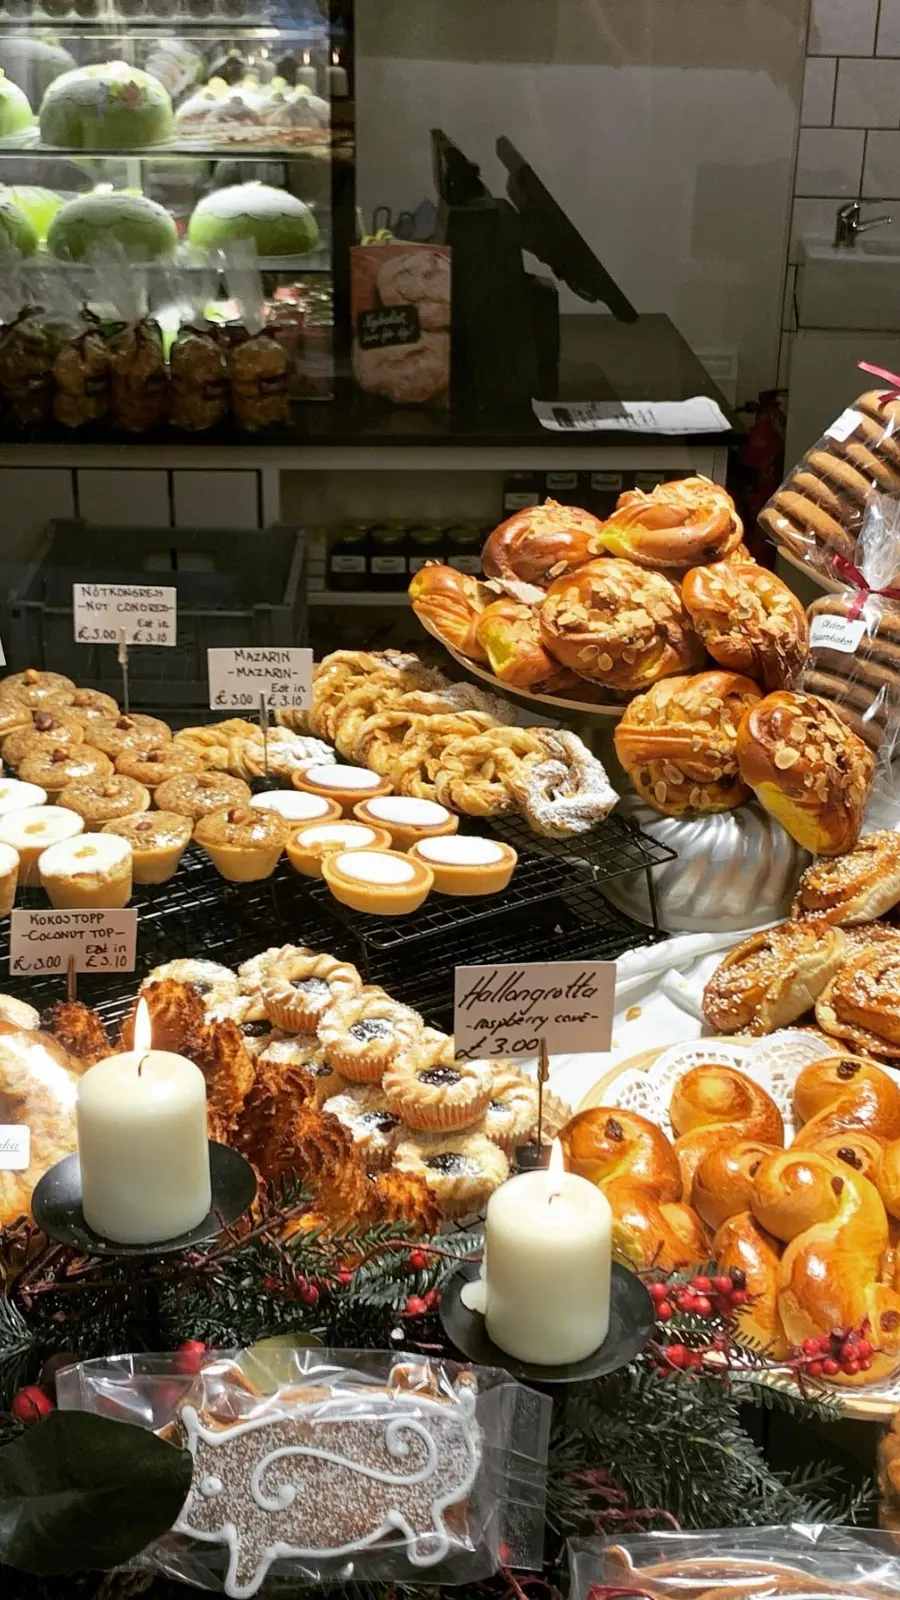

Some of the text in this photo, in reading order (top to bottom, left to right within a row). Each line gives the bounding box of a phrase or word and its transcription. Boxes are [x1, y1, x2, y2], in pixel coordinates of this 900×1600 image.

[137, 618, 153, 629] Eat
[234, 649, 291, 664] MAZARIN
[271, 682, 306, 693] Eat in
[29, 912, 105, 926] KOKOSTOPP
[85, 943, 127, 955] Eat in
[457, 970, 599, 1015] Hallongrotta
